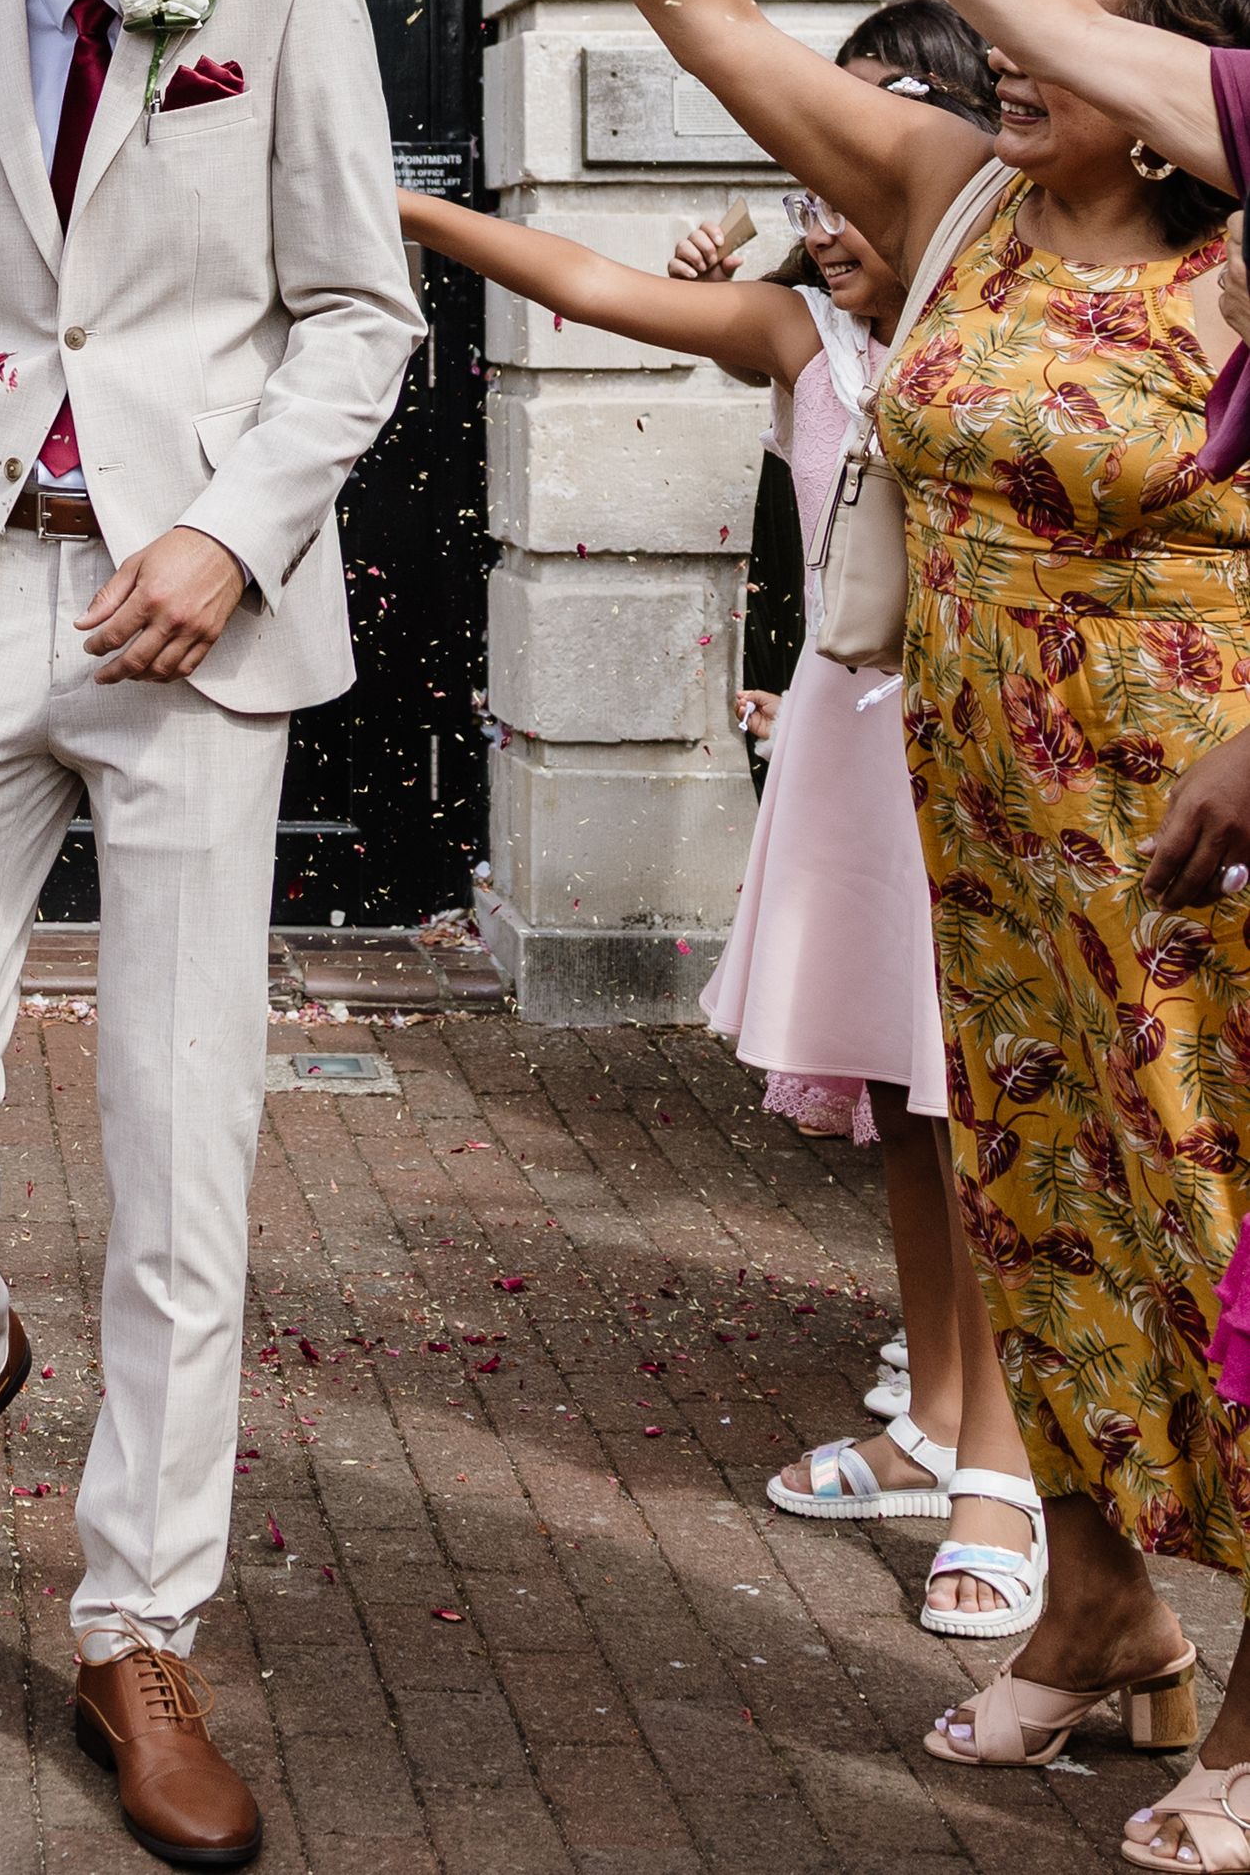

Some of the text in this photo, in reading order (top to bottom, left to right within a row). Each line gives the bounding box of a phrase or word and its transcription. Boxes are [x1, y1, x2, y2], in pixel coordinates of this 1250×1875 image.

[393, 154, 462, 165] PPOINTMENTS
[417, 169, 445, 177] OFFICE
[413, 178, 425, 186] ON
[426, 178, 441, 186] THE
[442, 177, 461, 186] LEFT
